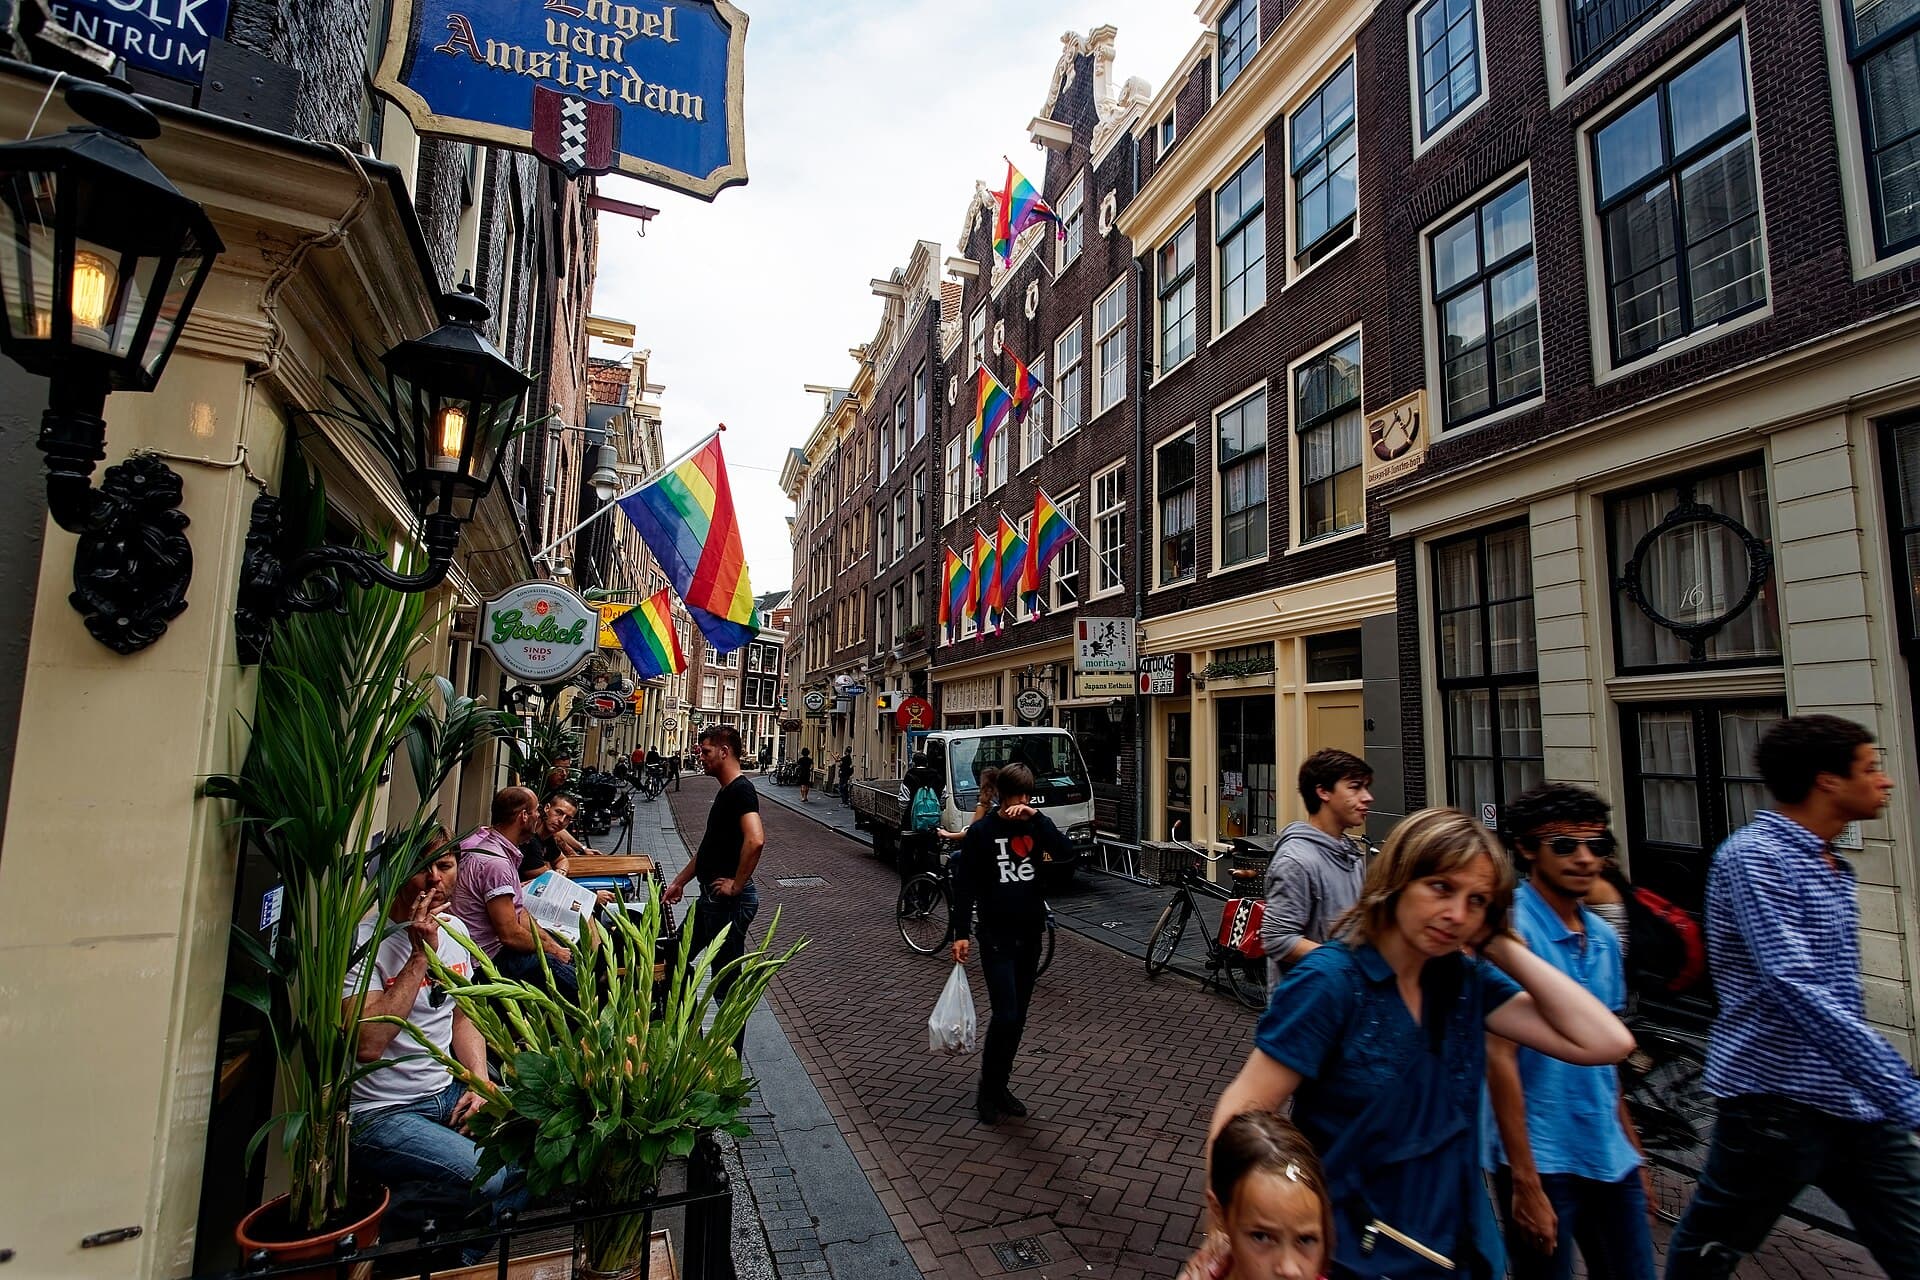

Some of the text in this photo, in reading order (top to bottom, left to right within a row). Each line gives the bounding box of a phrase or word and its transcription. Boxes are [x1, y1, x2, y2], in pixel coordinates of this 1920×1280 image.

[545, 17, 623, 63] van
[433, 13, 706, 121] Amsterdam
[1680, 582, 1705, 609] 16
[491, 608, 588, 645] Grolsch
[523, 646, 552, 655] SINDS
[528, 654, 546, 662] 1615
[1085, 658, 1126, 670] morita-ya
[1084, 682, 1107, 691] Japans
[1028, 795, 1045, 804] ZU
[994, 838, 1010, 860] I
[998, 857, 1035, 883] Ré
